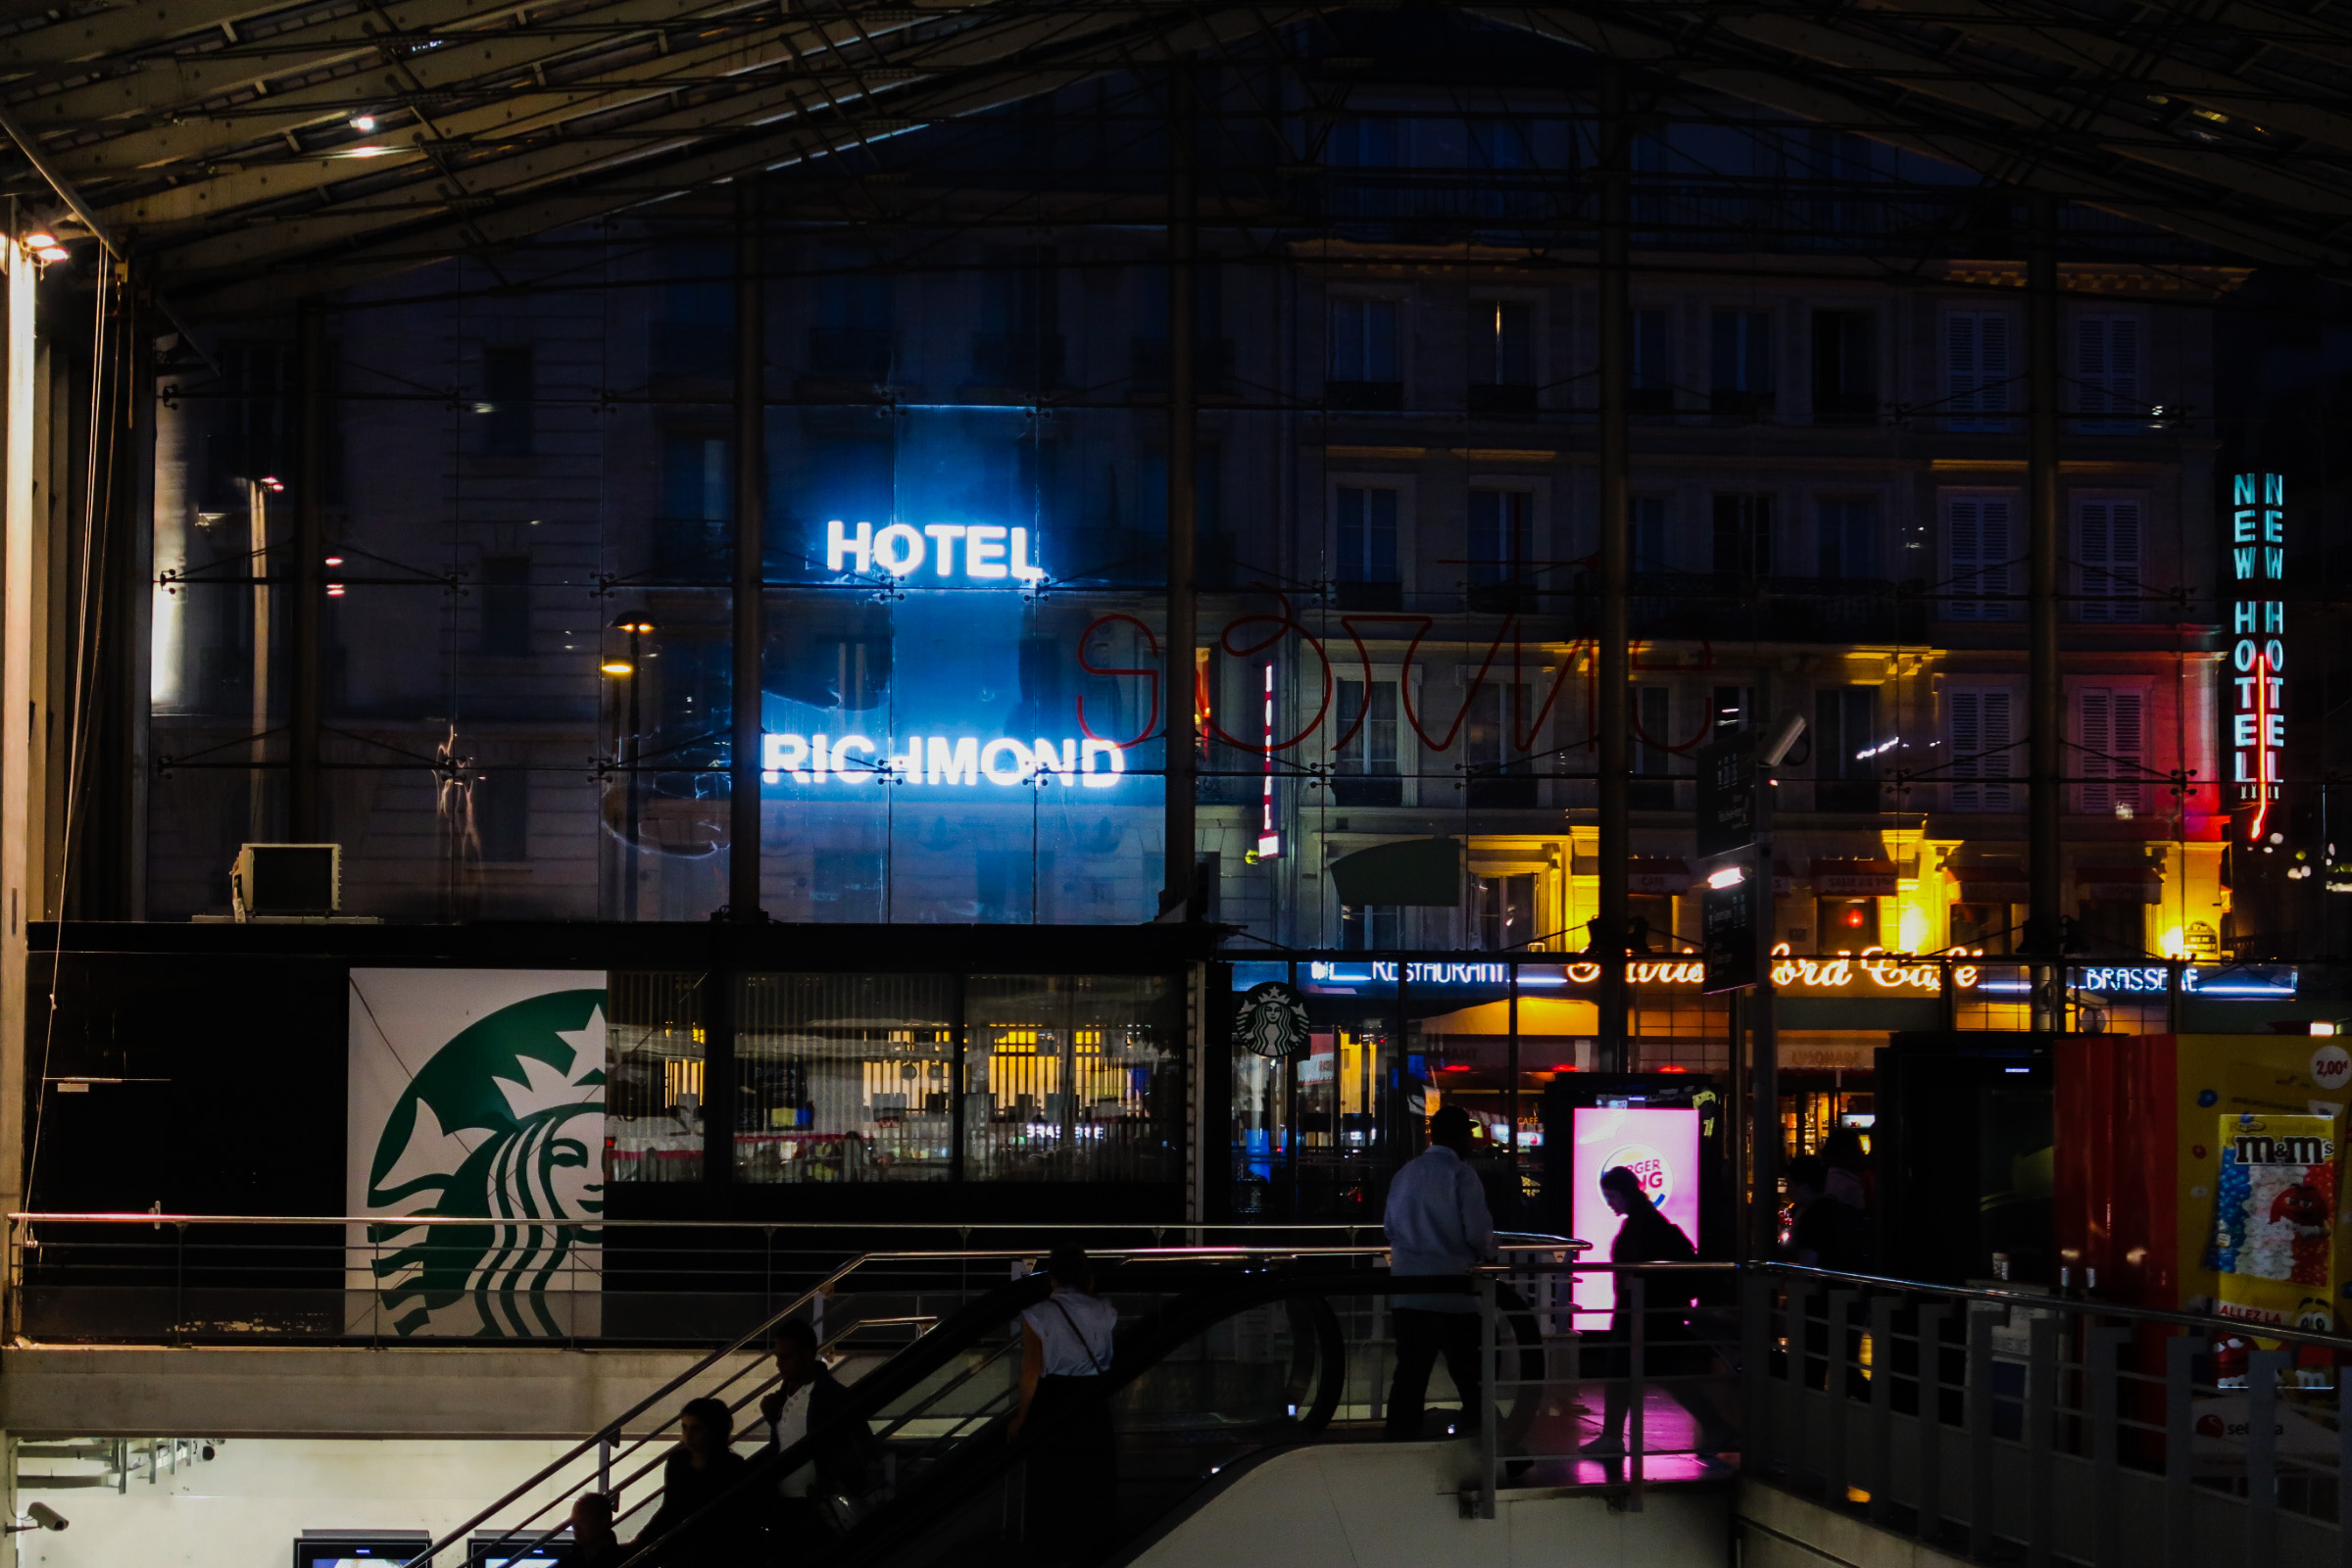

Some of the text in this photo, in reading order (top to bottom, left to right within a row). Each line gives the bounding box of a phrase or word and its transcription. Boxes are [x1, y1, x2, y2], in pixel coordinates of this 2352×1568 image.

[825, 519, 1044, 580] HOTEL
[2233, 472, 2258, 784] NEW HOTEL
[2265, 472, 2285, 784] NEW HOTEL
[760, 733, 1125, 788] RICHMOND
[1371, 960, 1506, 984] RESTAURANT
[2085, 967, 2198, 992] BRASSEIE
[2219, 1304, 2261, 1321] ALLEZ
